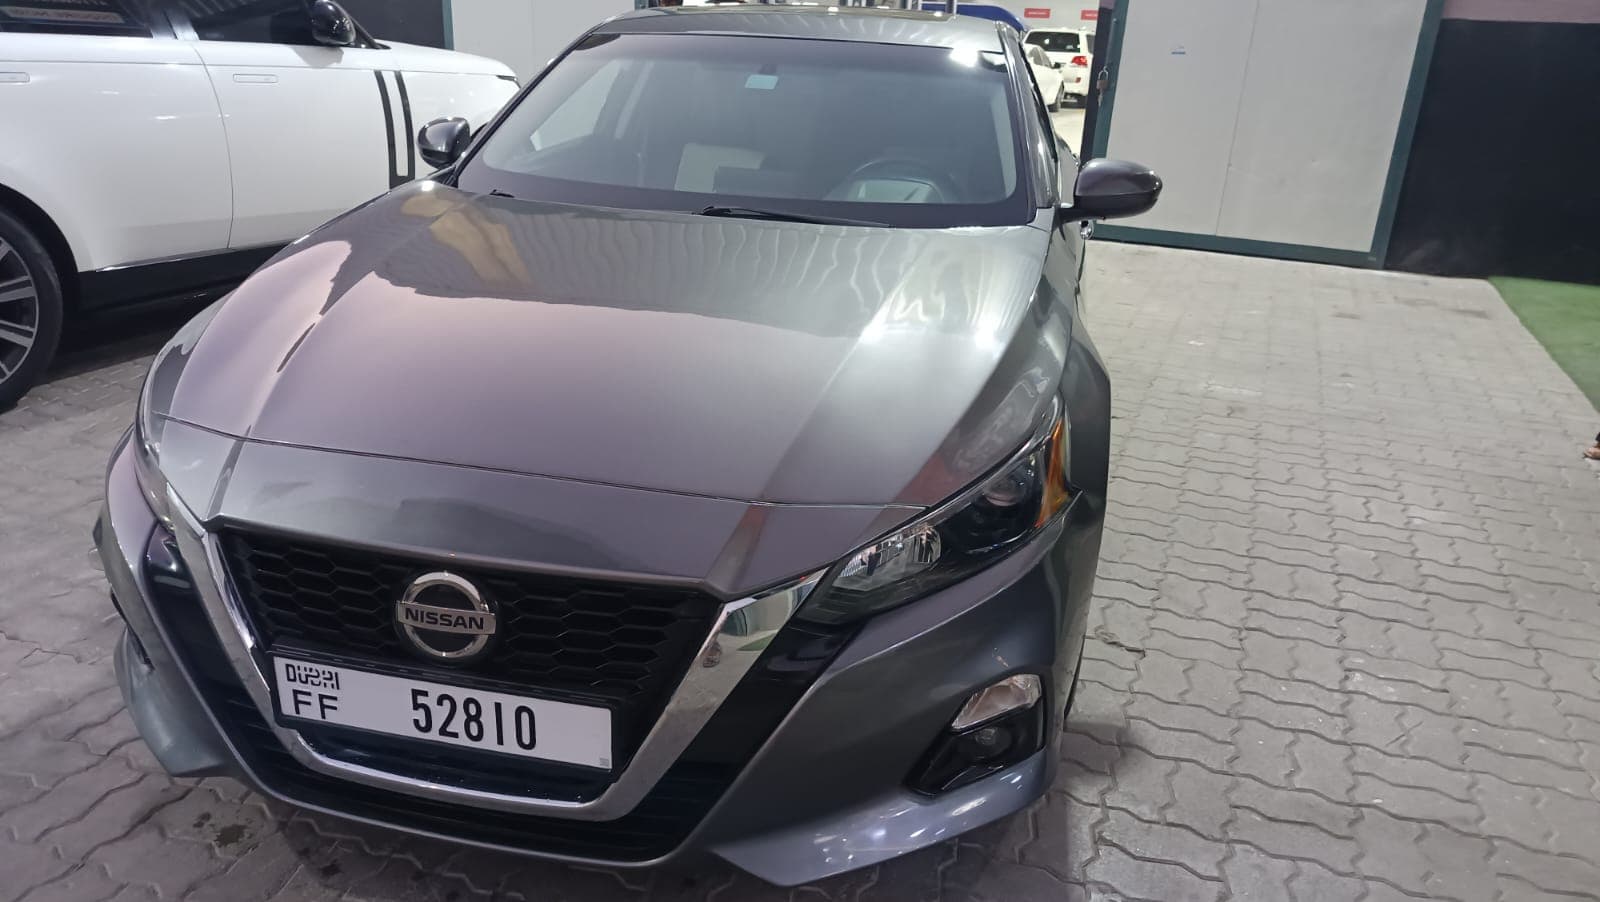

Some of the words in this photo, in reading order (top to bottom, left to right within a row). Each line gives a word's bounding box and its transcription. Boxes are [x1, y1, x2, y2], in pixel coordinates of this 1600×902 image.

[405, 607, 484, 631] NISSAN
[292, 689, 338, 719] FF
[411, 688, 537, 750] 52810
